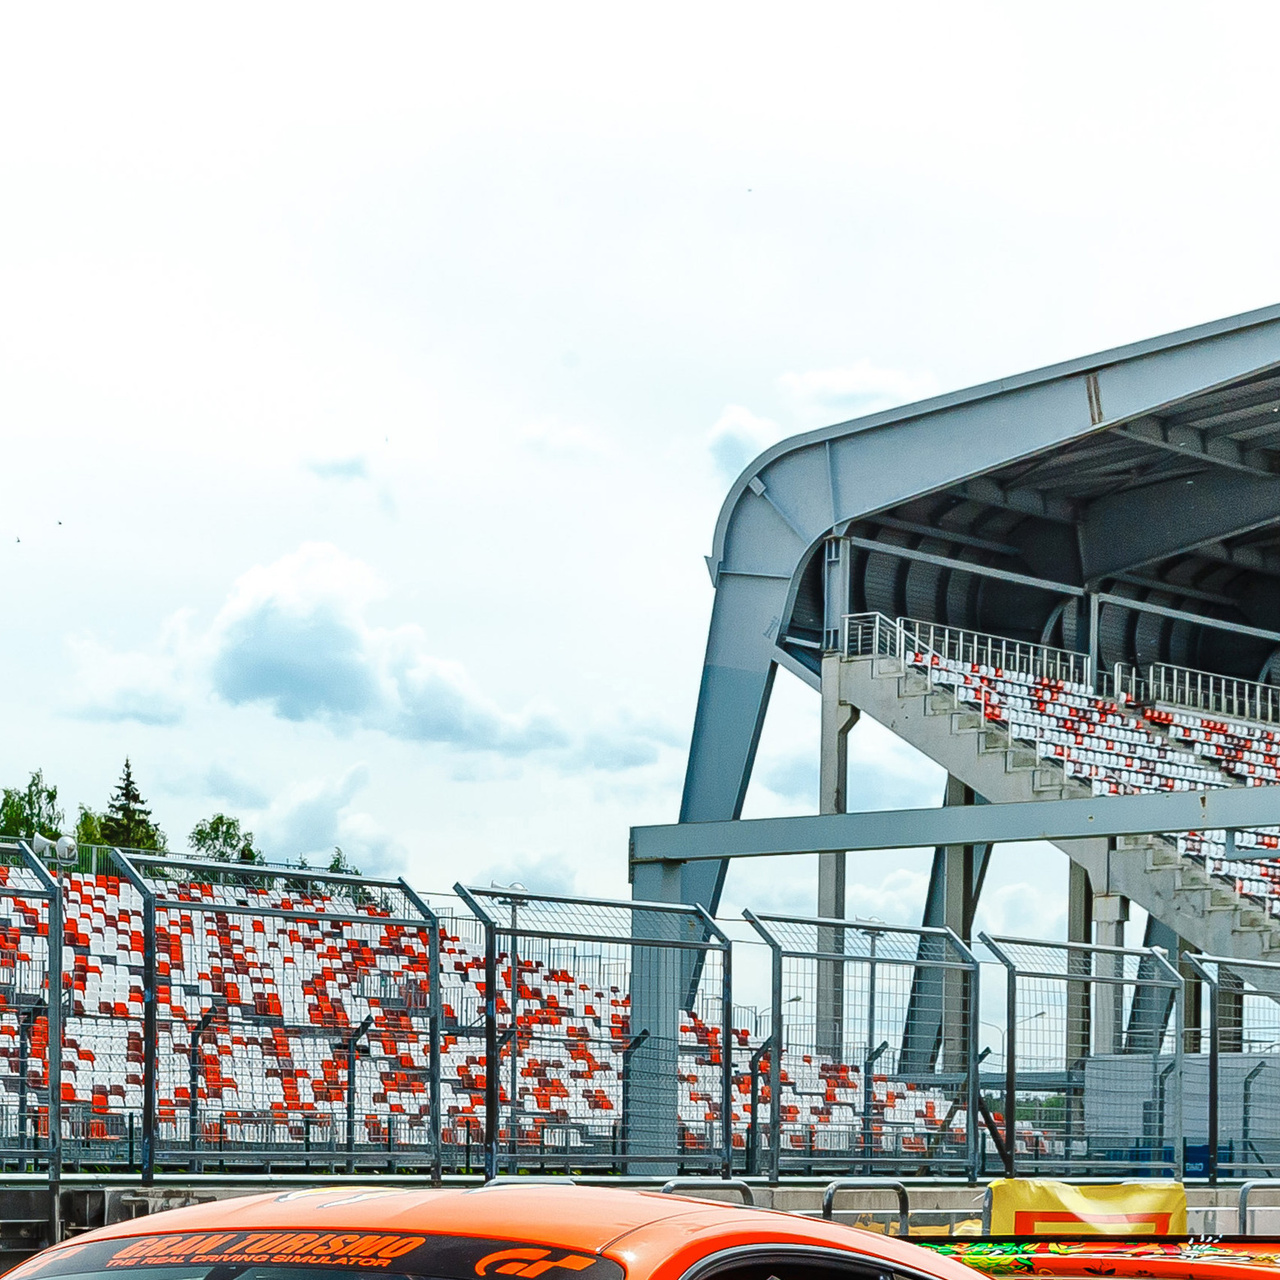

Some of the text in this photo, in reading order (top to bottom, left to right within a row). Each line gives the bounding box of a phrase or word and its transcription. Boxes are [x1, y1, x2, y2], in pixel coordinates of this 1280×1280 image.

[112, 1233, 427, 1259] GRAN TURISMO
[106, 1253, 393, 1268] THE REAL DRIVING SIMULATOR
